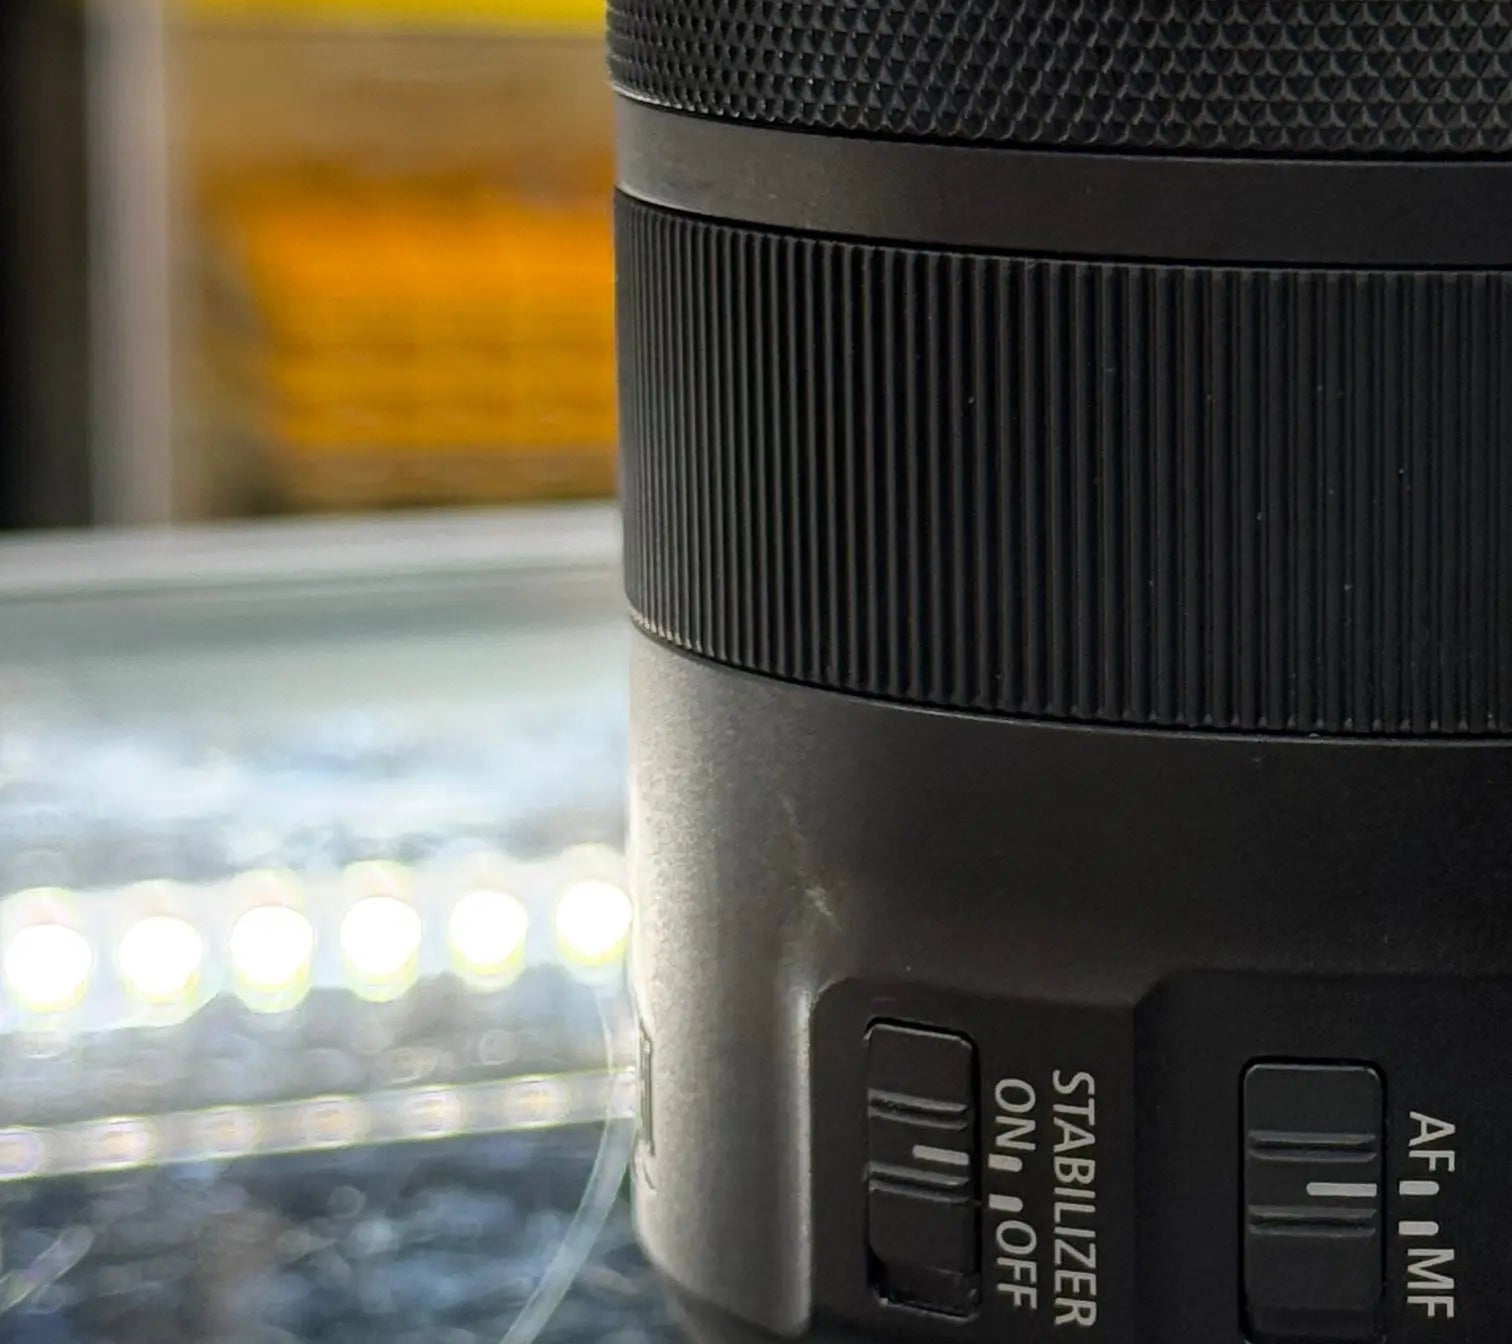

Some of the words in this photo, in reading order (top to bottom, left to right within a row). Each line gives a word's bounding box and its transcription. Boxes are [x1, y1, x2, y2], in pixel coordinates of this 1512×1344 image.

[994, 1078, 1036, 1151] ON
[1408, 1111, 1456, 1172] AF
[1052, 1069, 1097, 1326] STABILIZER
[996, 1220, 1037, 1309] OFF
[1407, 1248, 1455, 1318] MF
